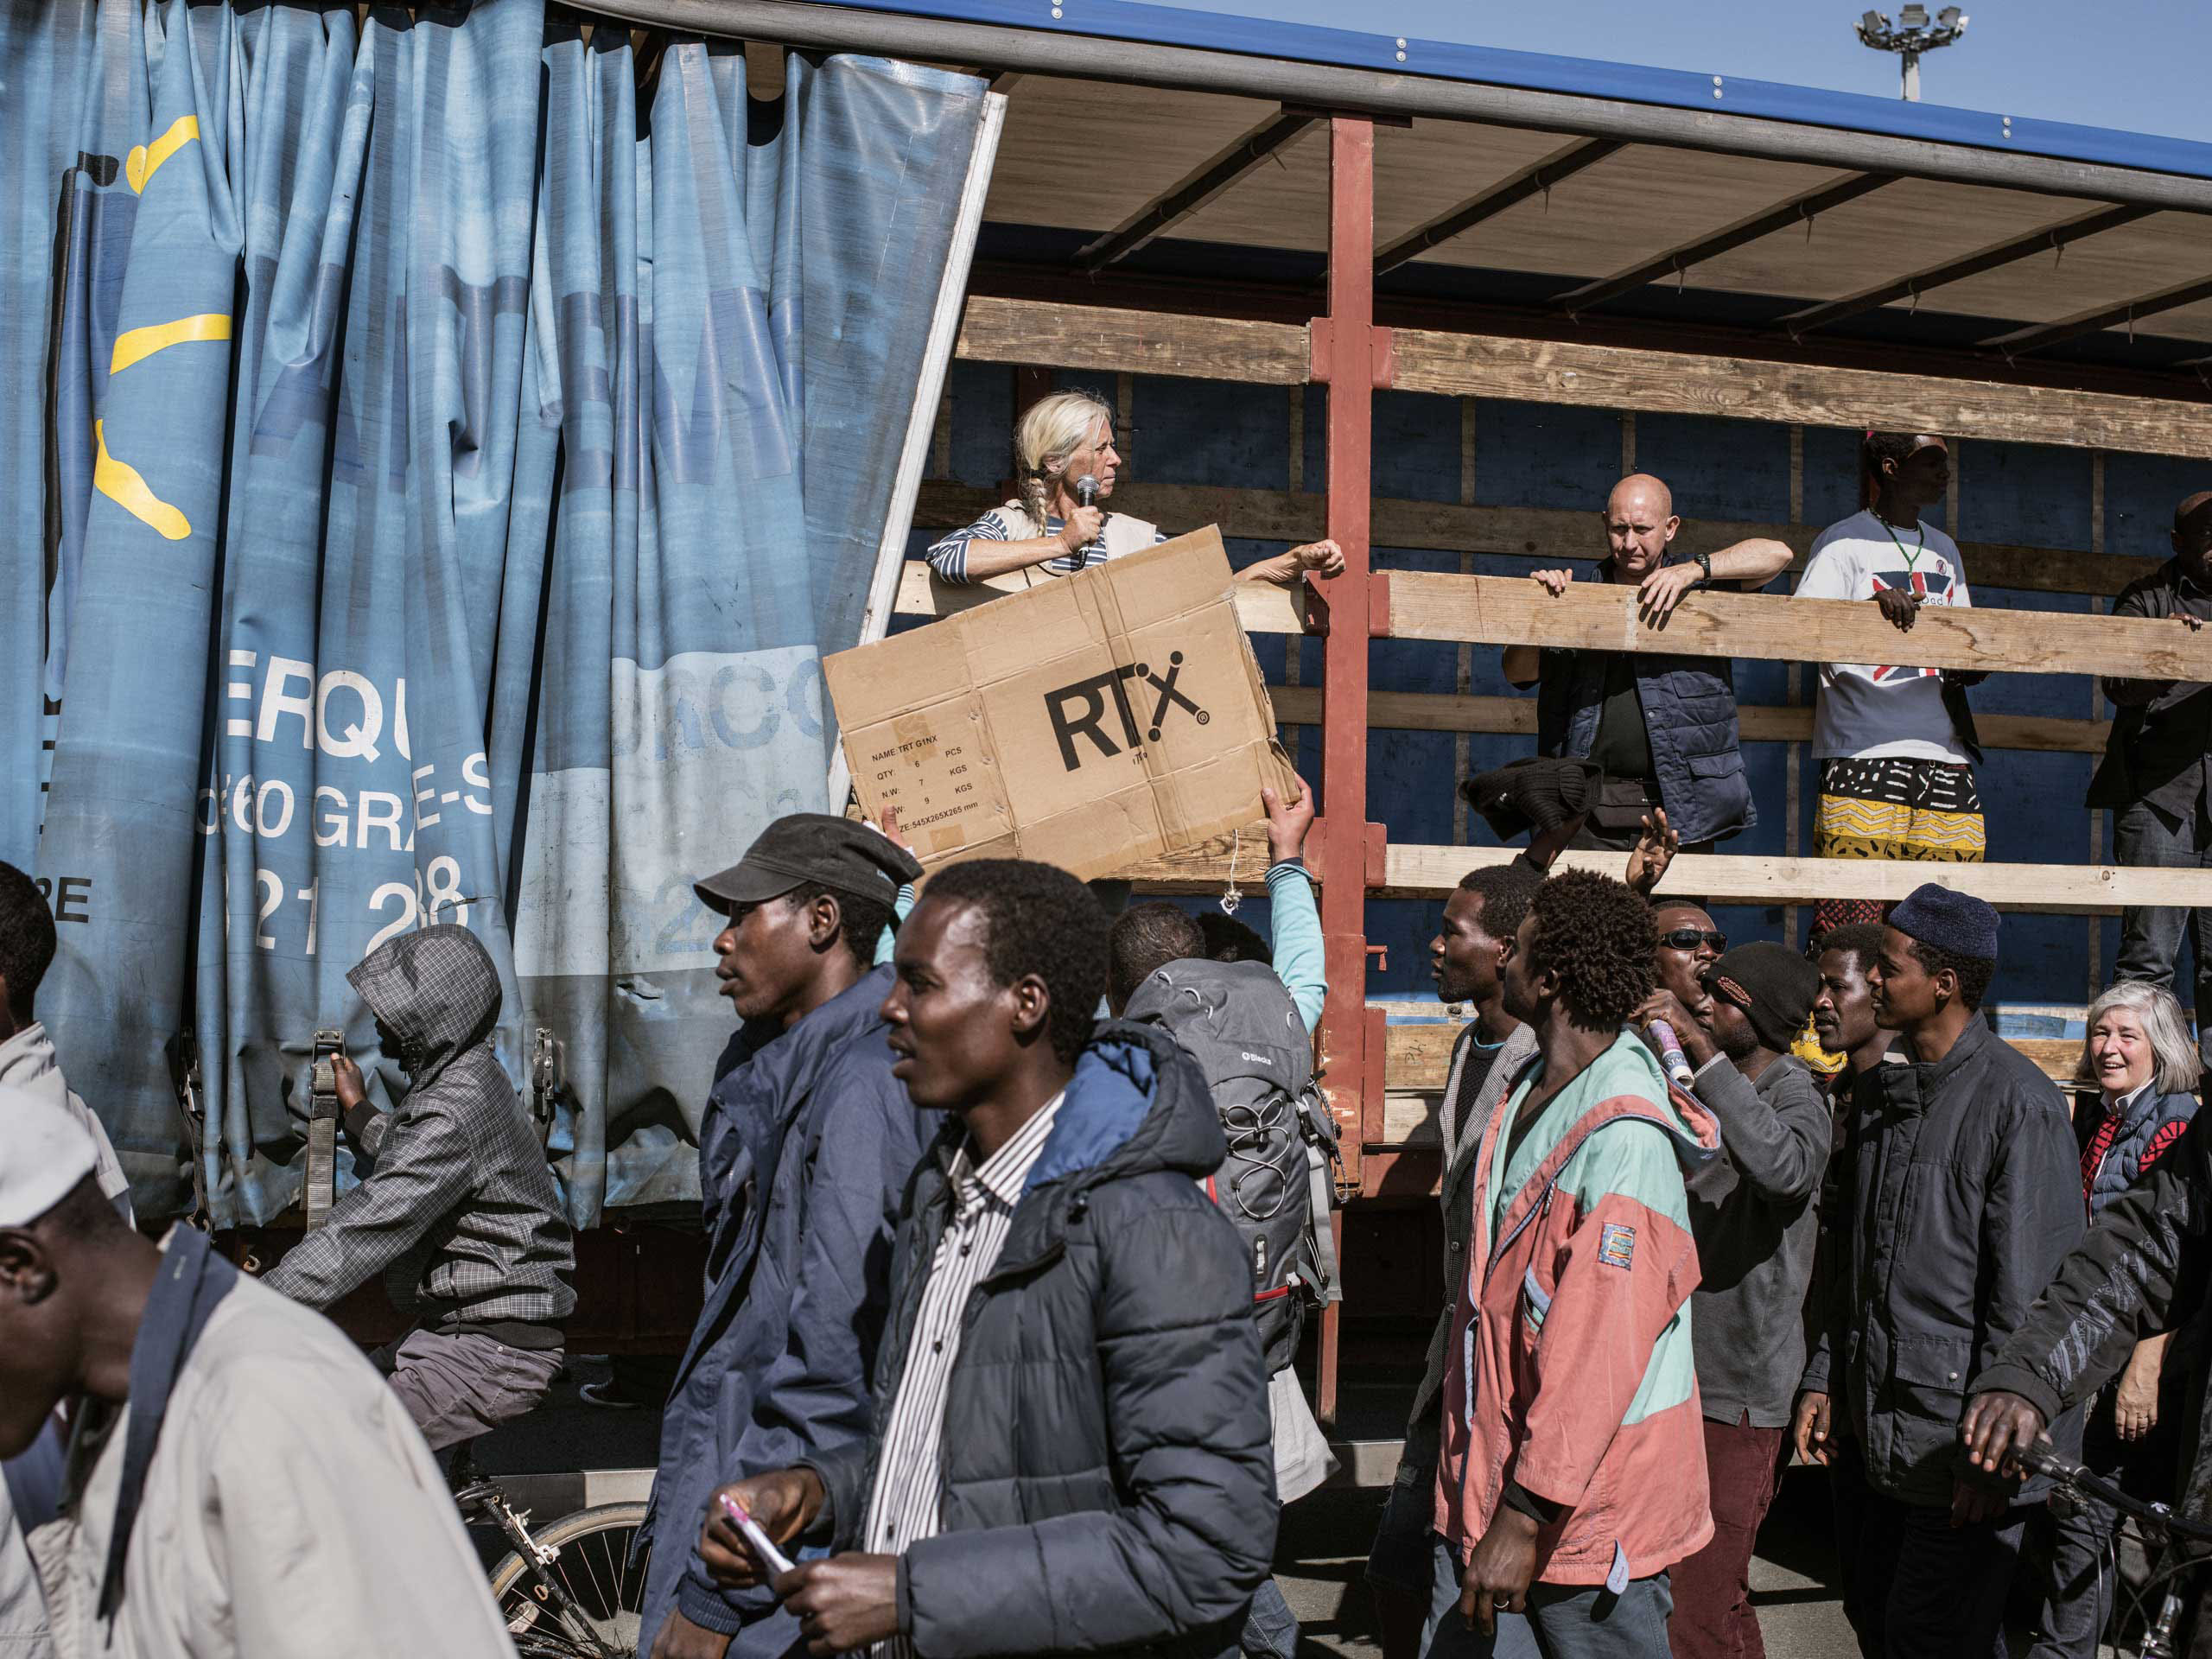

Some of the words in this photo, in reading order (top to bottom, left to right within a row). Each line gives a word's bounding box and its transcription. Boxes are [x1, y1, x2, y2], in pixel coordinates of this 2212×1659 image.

[1044, 650, 1211, 772] RTX
[877, 769, 896, 781] QTY:
[945, 747, 962, 758] PCS
[881, 787, 900, 799] N.W:
[949, 765, 968, 777] KGS
[954, 783, 973, 795] KGS
[899, 806, 963, 833] ZE:545X265X265
[963, 802, 979, 811] mm
